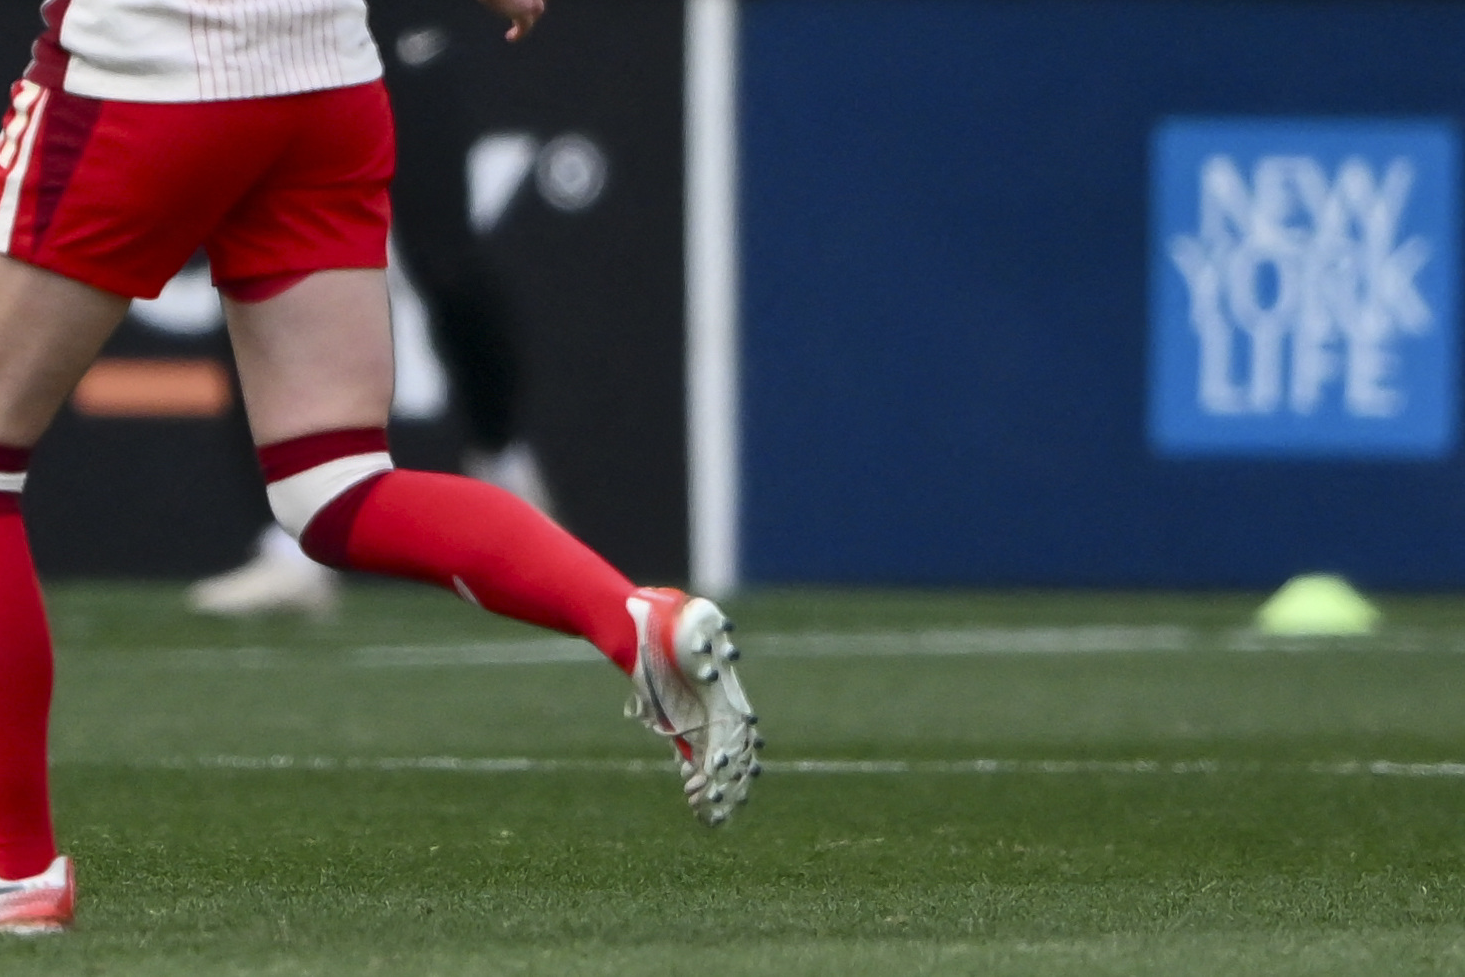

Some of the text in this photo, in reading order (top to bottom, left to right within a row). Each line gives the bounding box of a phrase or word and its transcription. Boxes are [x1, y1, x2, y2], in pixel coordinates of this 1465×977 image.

[1199, 153, 1416, 245] NEW
[1169, 232, 1433, 335] YORK
[1199, 322, 1407, 418] LIFE
